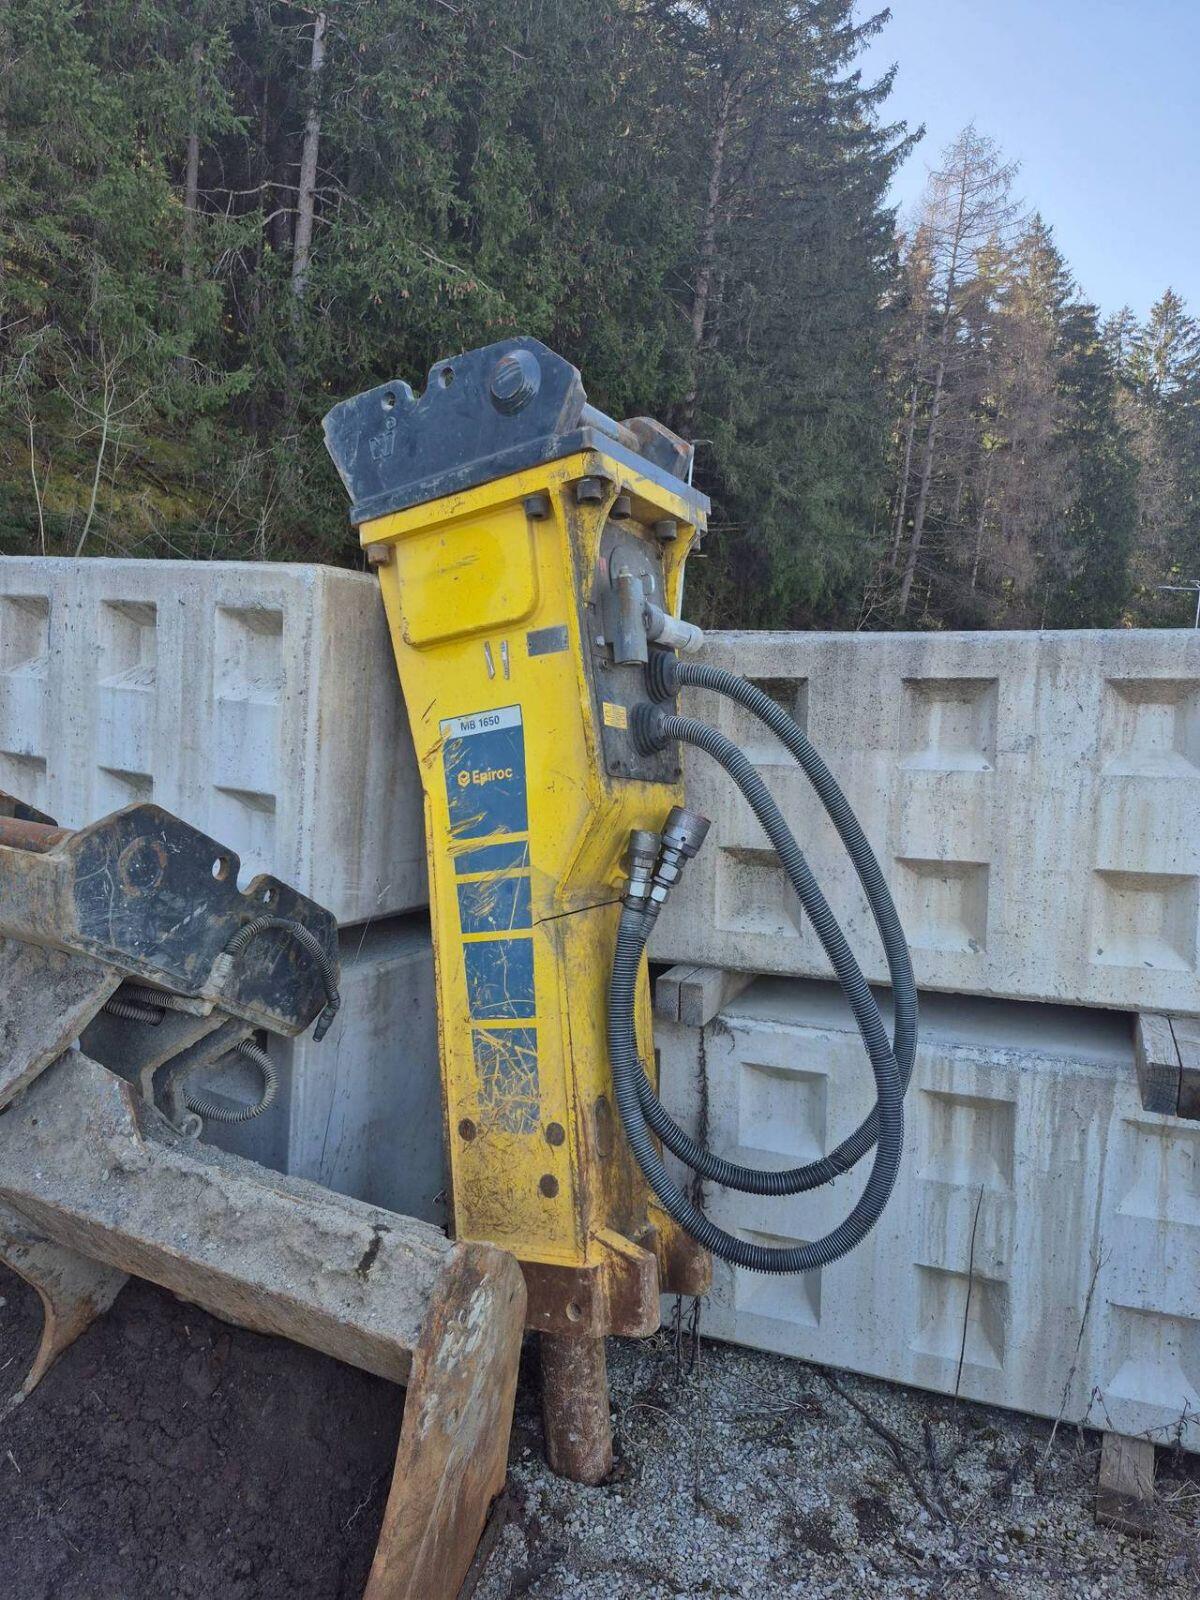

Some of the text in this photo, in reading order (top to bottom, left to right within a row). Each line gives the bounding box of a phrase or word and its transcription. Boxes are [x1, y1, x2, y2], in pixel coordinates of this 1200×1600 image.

[460, 715, 500, 731] MB 1650
[472, 767, 513, 786] Epiroc
